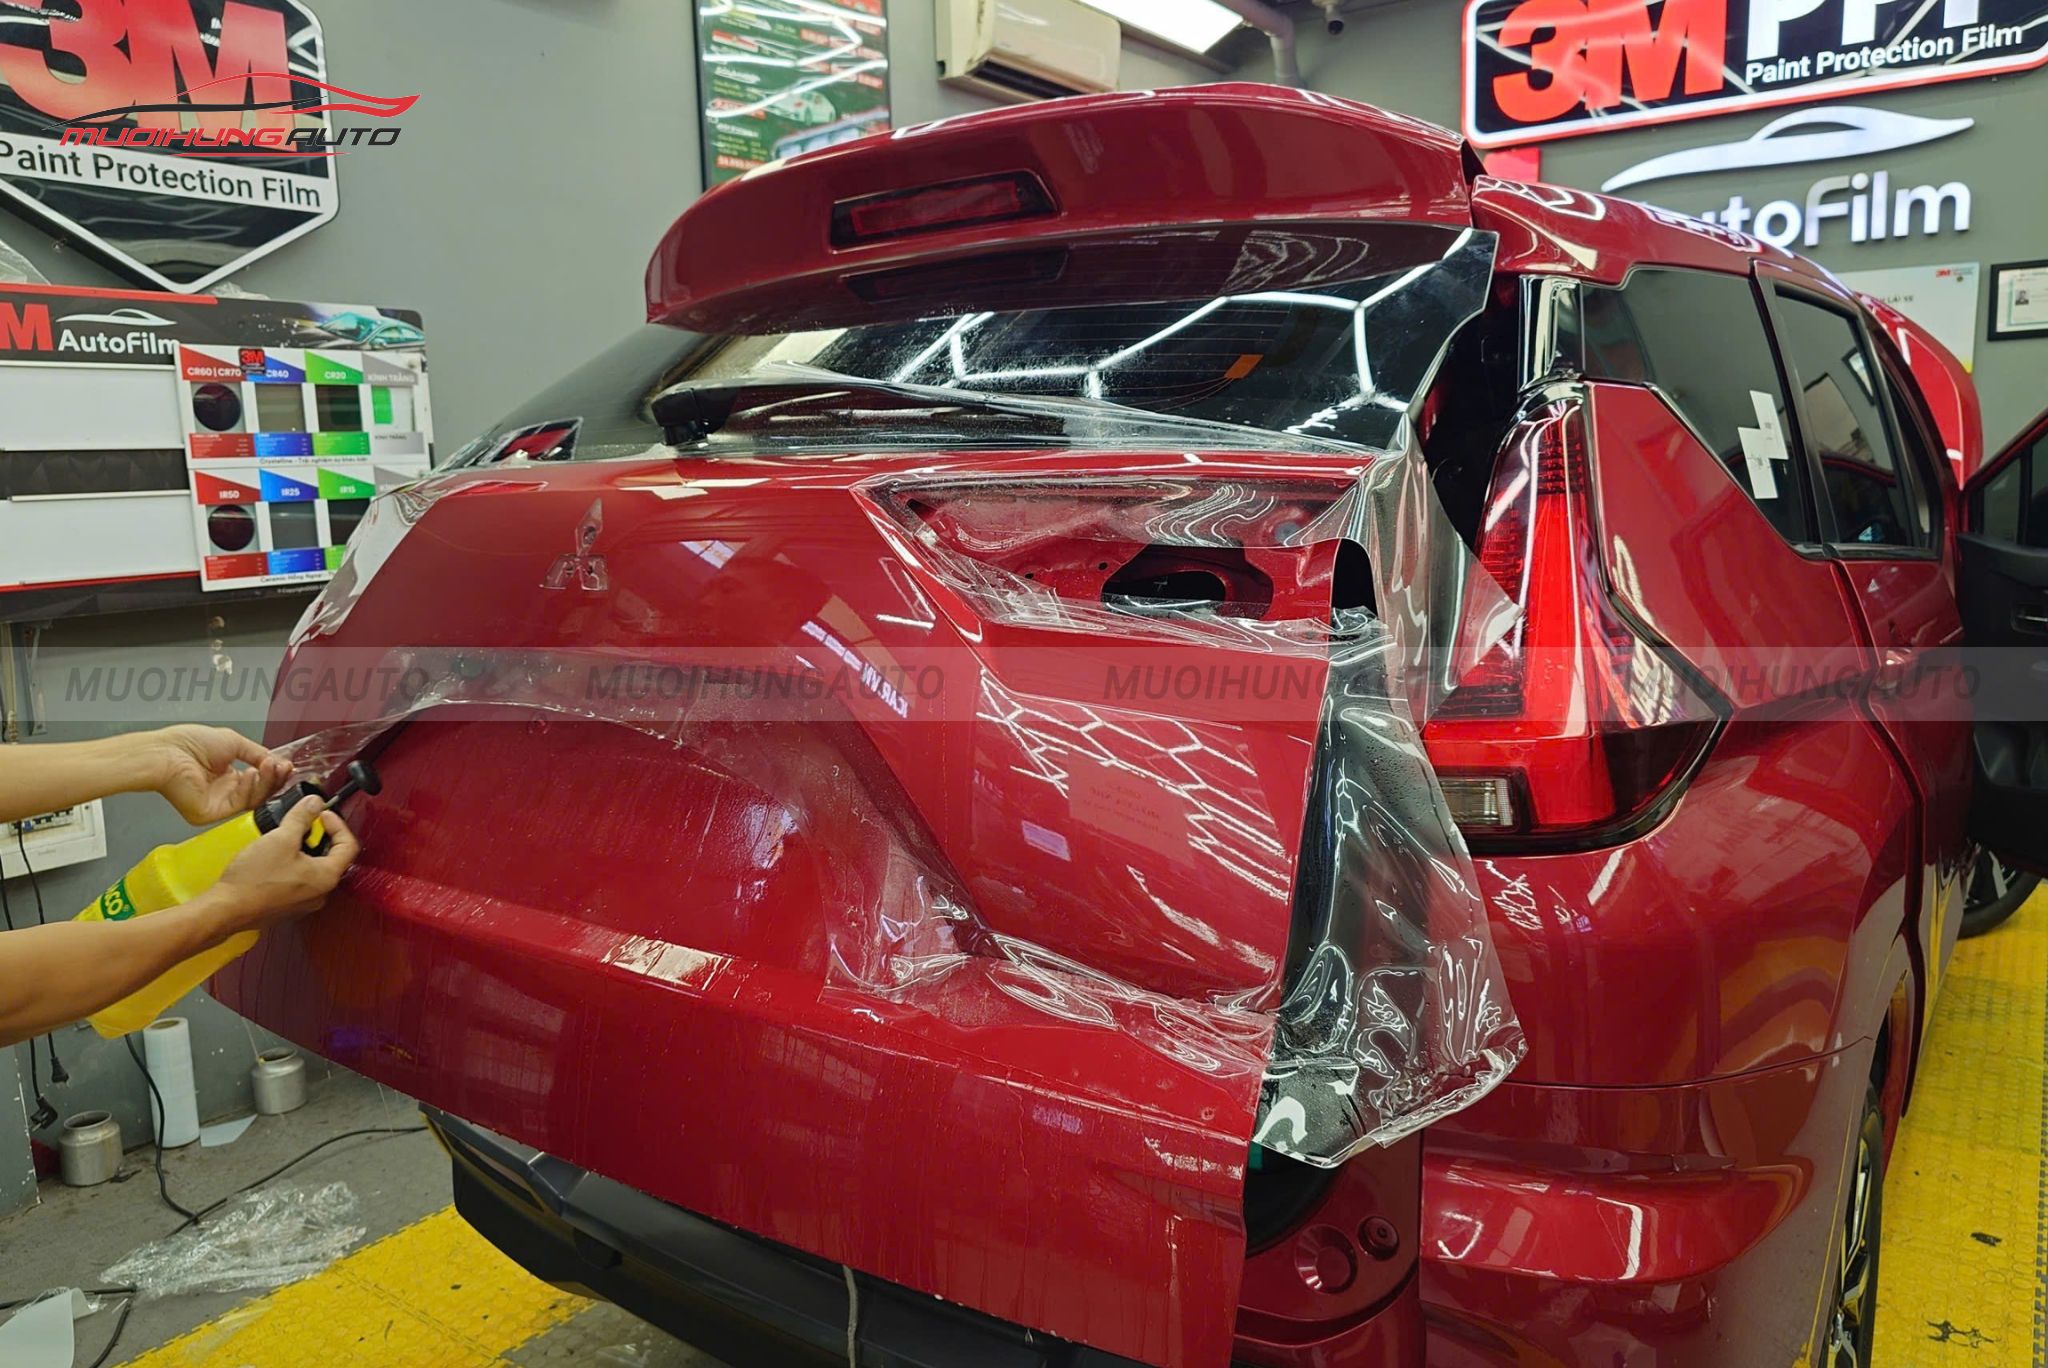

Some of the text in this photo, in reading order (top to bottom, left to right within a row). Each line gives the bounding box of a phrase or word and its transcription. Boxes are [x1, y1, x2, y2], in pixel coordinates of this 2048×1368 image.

[0, 0, 298, 152] 3M
[1493, 0, 1727, 122] 3M
[1746, 24, 2023, 85] Paint Protection Film
[0, 140, 322, 208] Paint Protection Film
[1701, 170, 1972, 248] toFilm
[58, 328, 180, 355] AutoFilm
